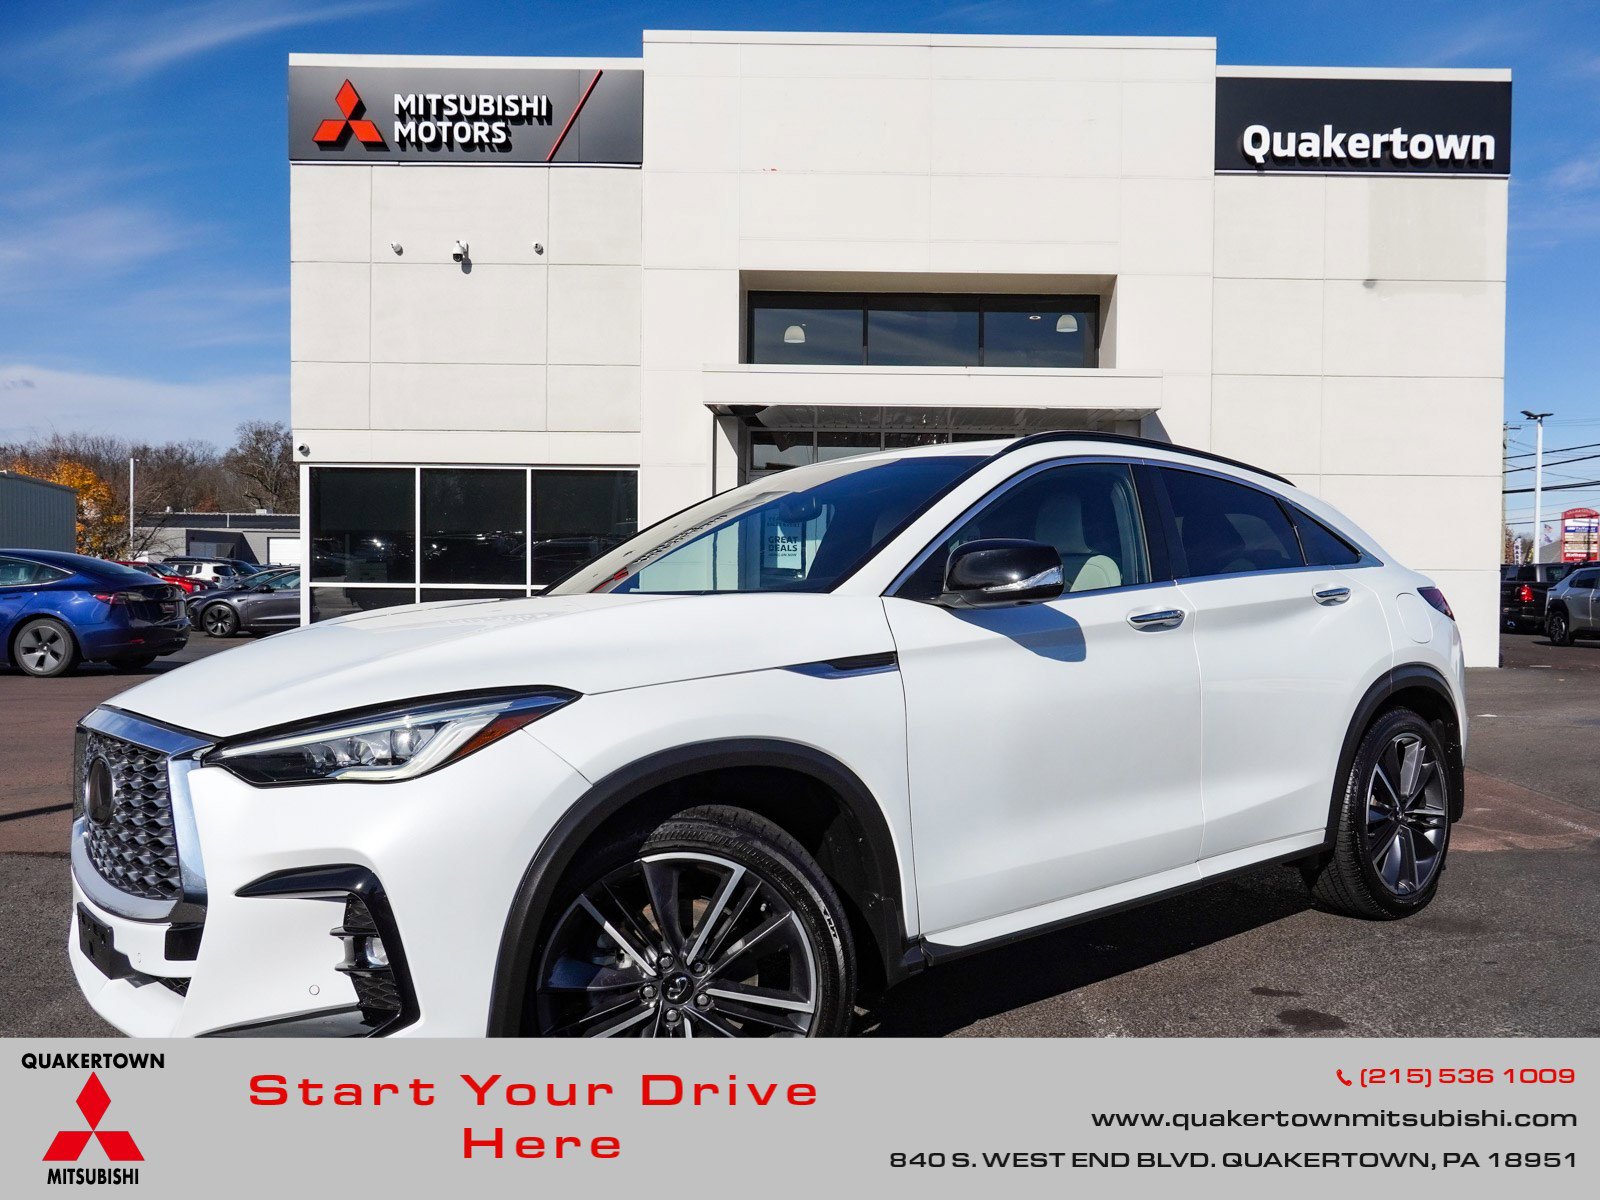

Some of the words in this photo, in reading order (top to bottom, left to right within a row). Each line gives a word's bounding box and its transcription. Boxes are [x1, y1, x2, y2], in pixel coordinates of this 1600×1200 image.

[393, 93, 548, 117] MITSUBISHI
[393, 121, 507, 144] MOTORS
[1243, 124, 1496, 164] Quakertown
[768, 535, 798, 544] GREAT
